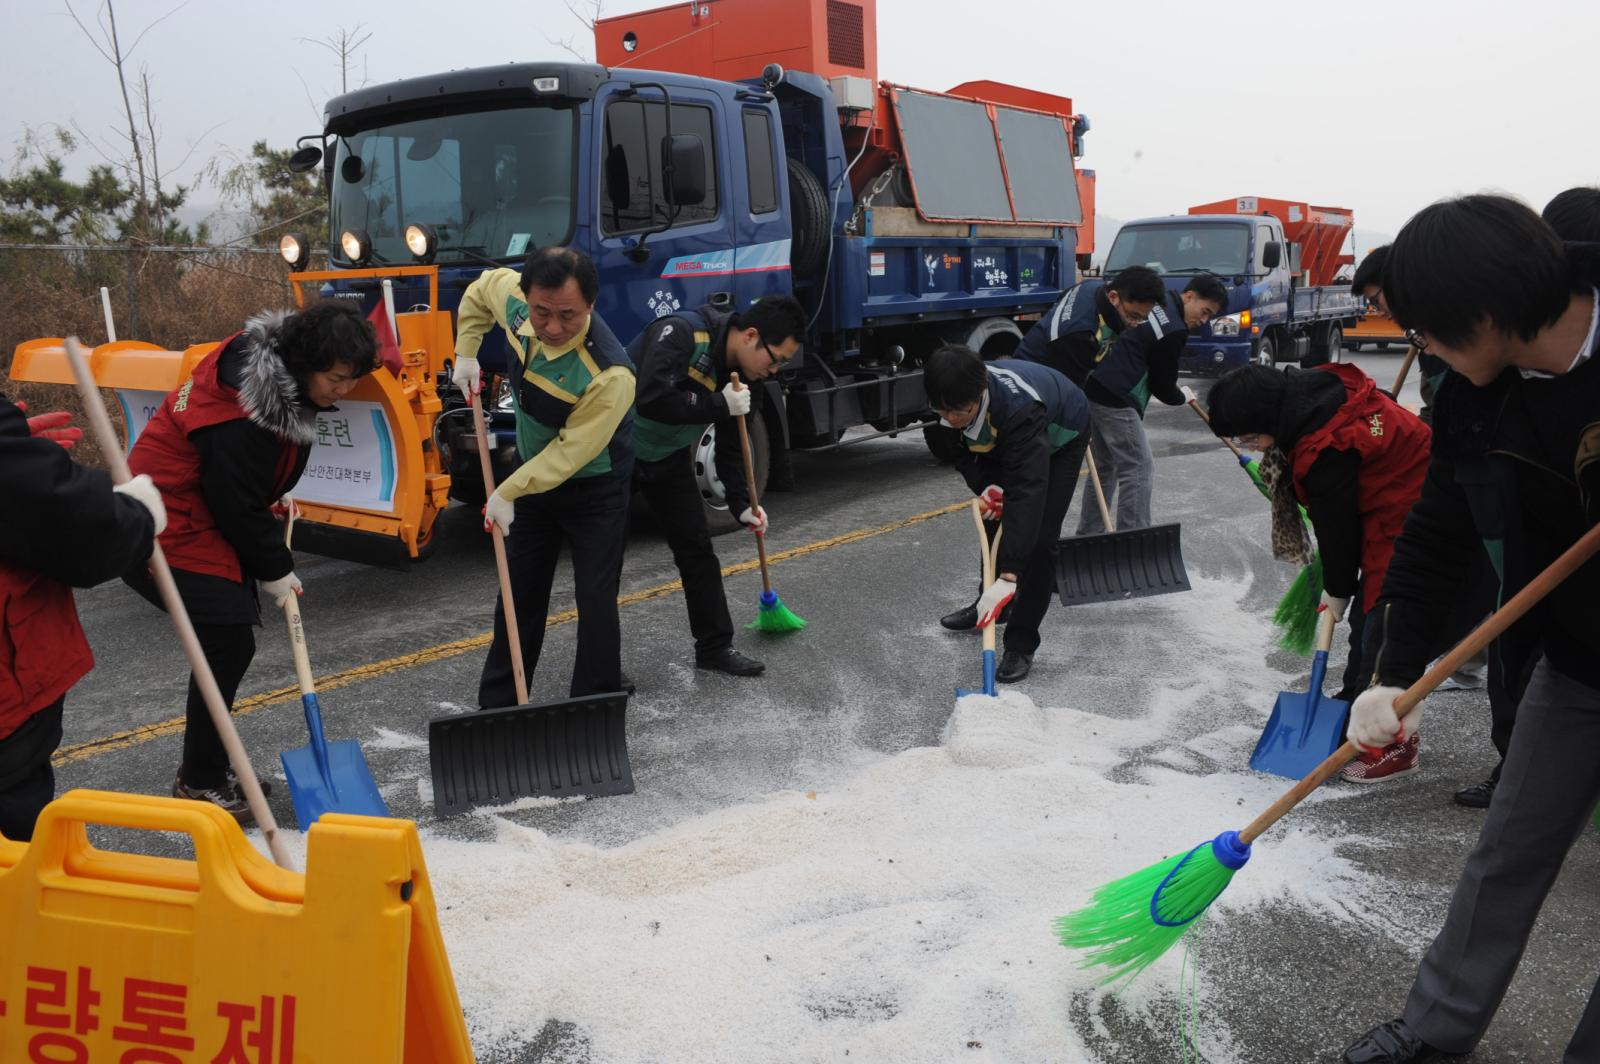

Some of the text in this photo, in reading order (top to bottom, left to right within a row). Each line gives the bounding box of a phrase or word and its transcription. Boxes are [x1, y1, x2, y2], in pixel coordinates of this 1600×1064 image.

[675, 261, 702, 271] MEGA
[943, 252, 961, 269] 함께
[984, 268, 1009, 286] 행복한
[316, 417, 354, 448] 훈련
[0, 965, 297, 1064] 량통제
